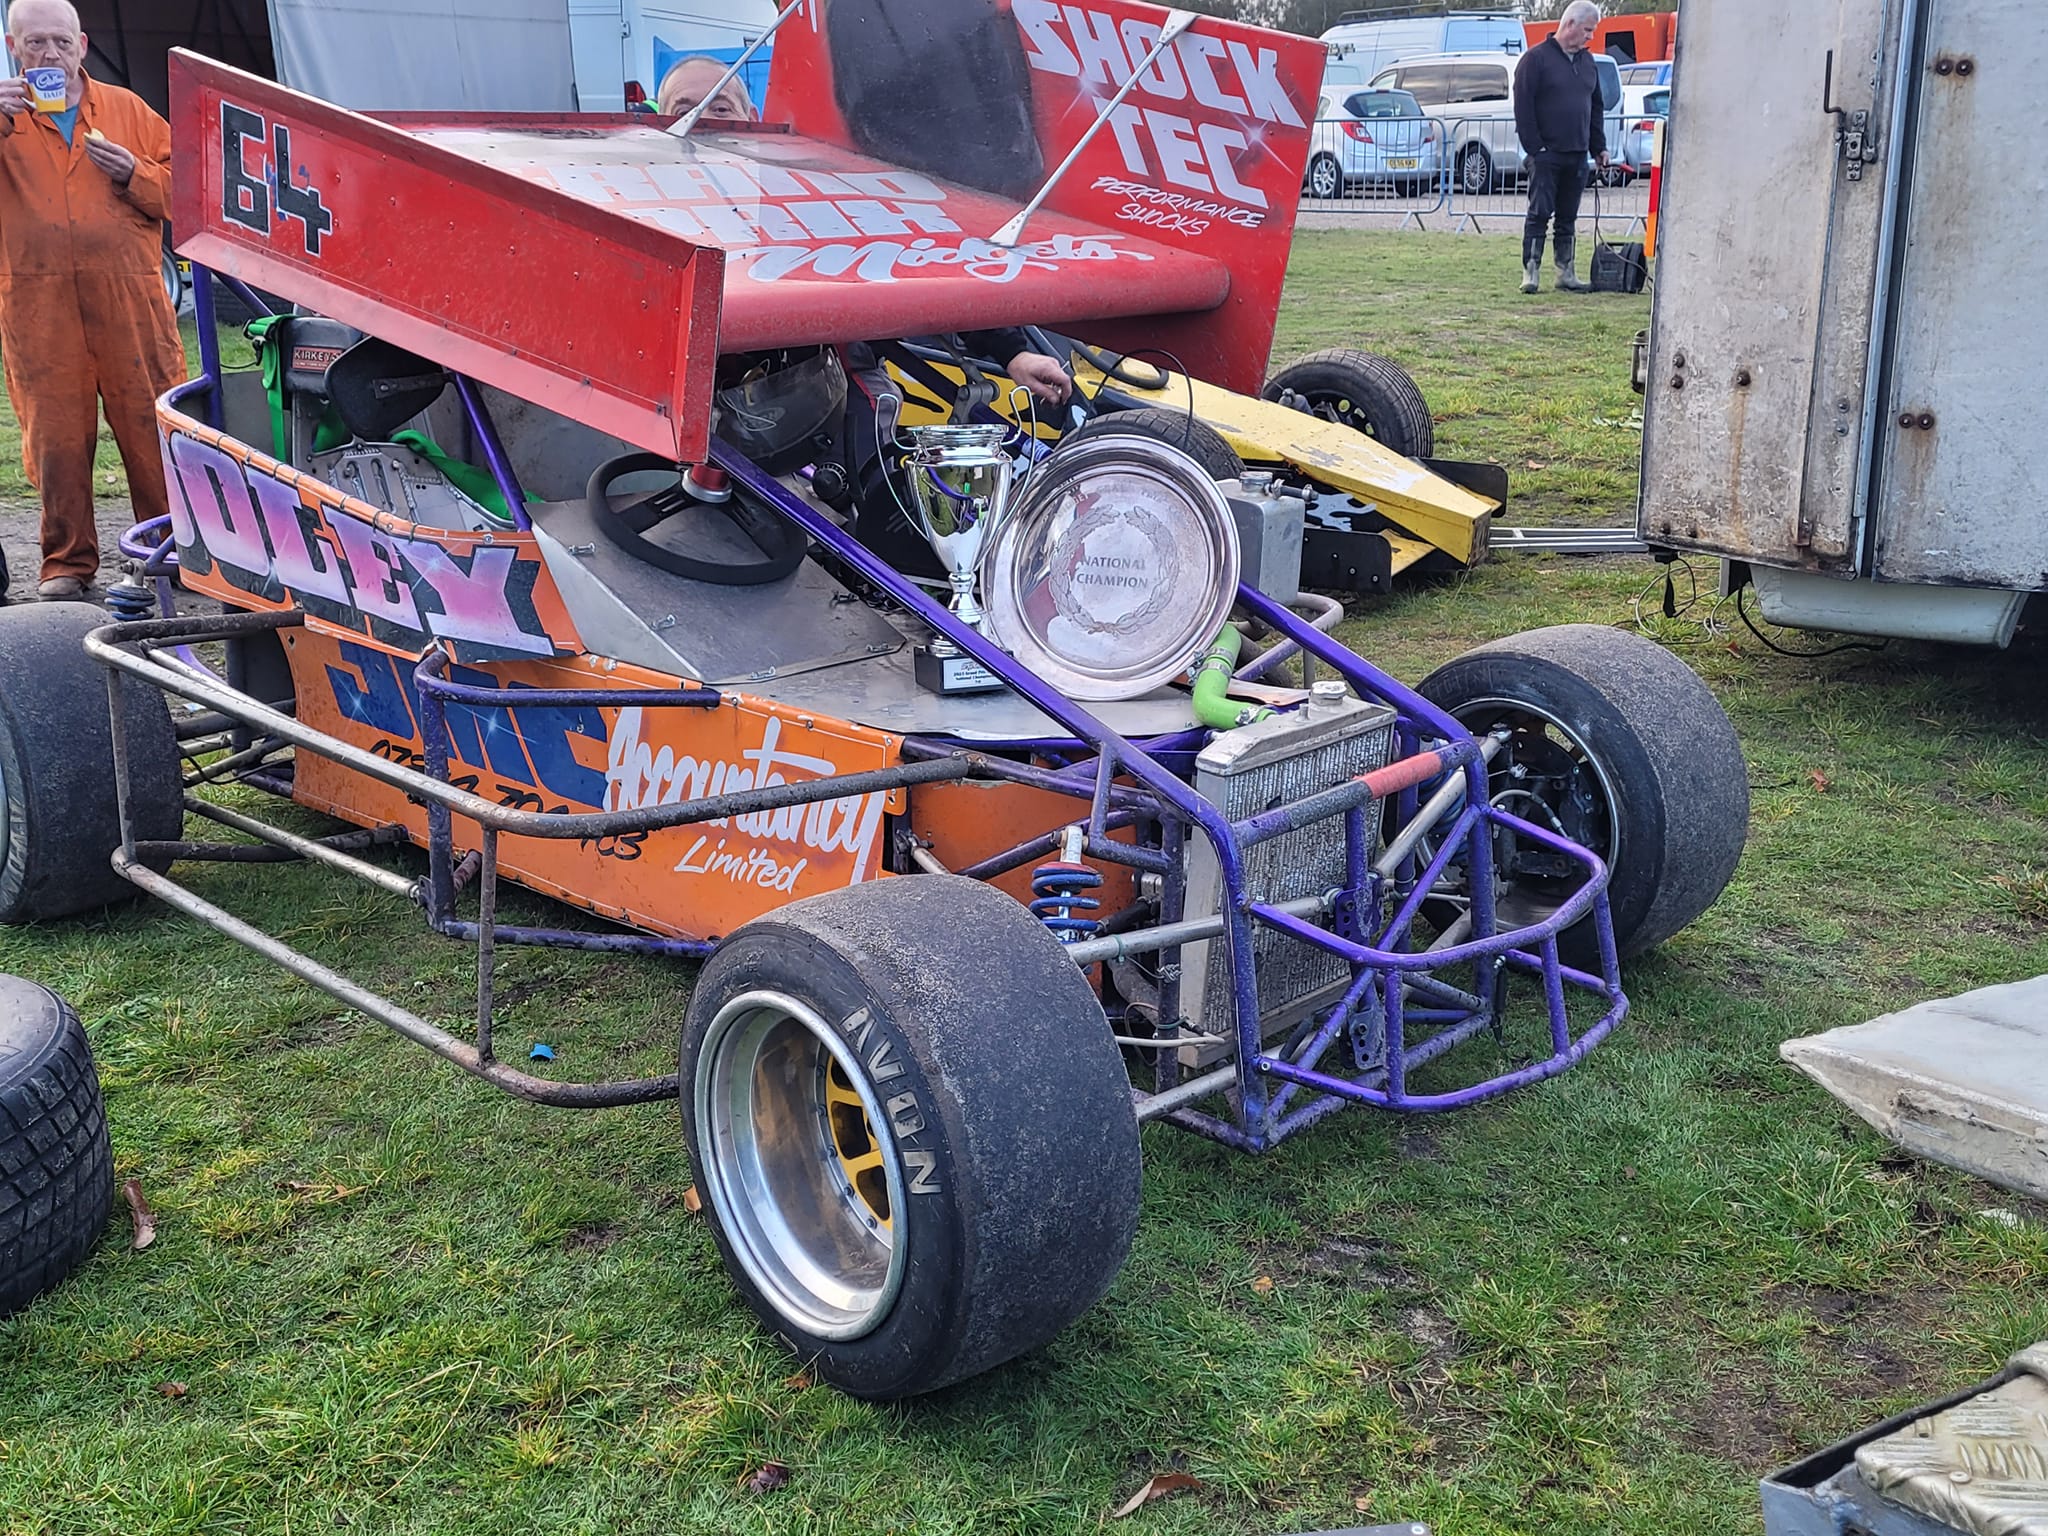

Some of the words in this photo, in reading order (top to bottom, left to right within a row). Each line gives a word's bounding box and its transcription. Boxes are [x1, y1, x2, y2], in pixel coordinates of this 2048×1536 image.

[1011, 0, 1308, 129] SHOCK
[220, 99, 333, 257] 64
[1093, 96, 1269, 209] TEC
[1090, 176, 1266, 229] PERFORMANCE
[1115, 203, 1211, 237] SHOCKS
[726, 234, 1155, 284] Midgets
[1076, 573, 1149, 589] CHAMPION
[1079, 556, 1146, 570] NATIONAL
[603, 707, 886, 885] Accountancy
[674, 836, 807, 894] Limited
[841, 1006, 942, 1195] AVON
